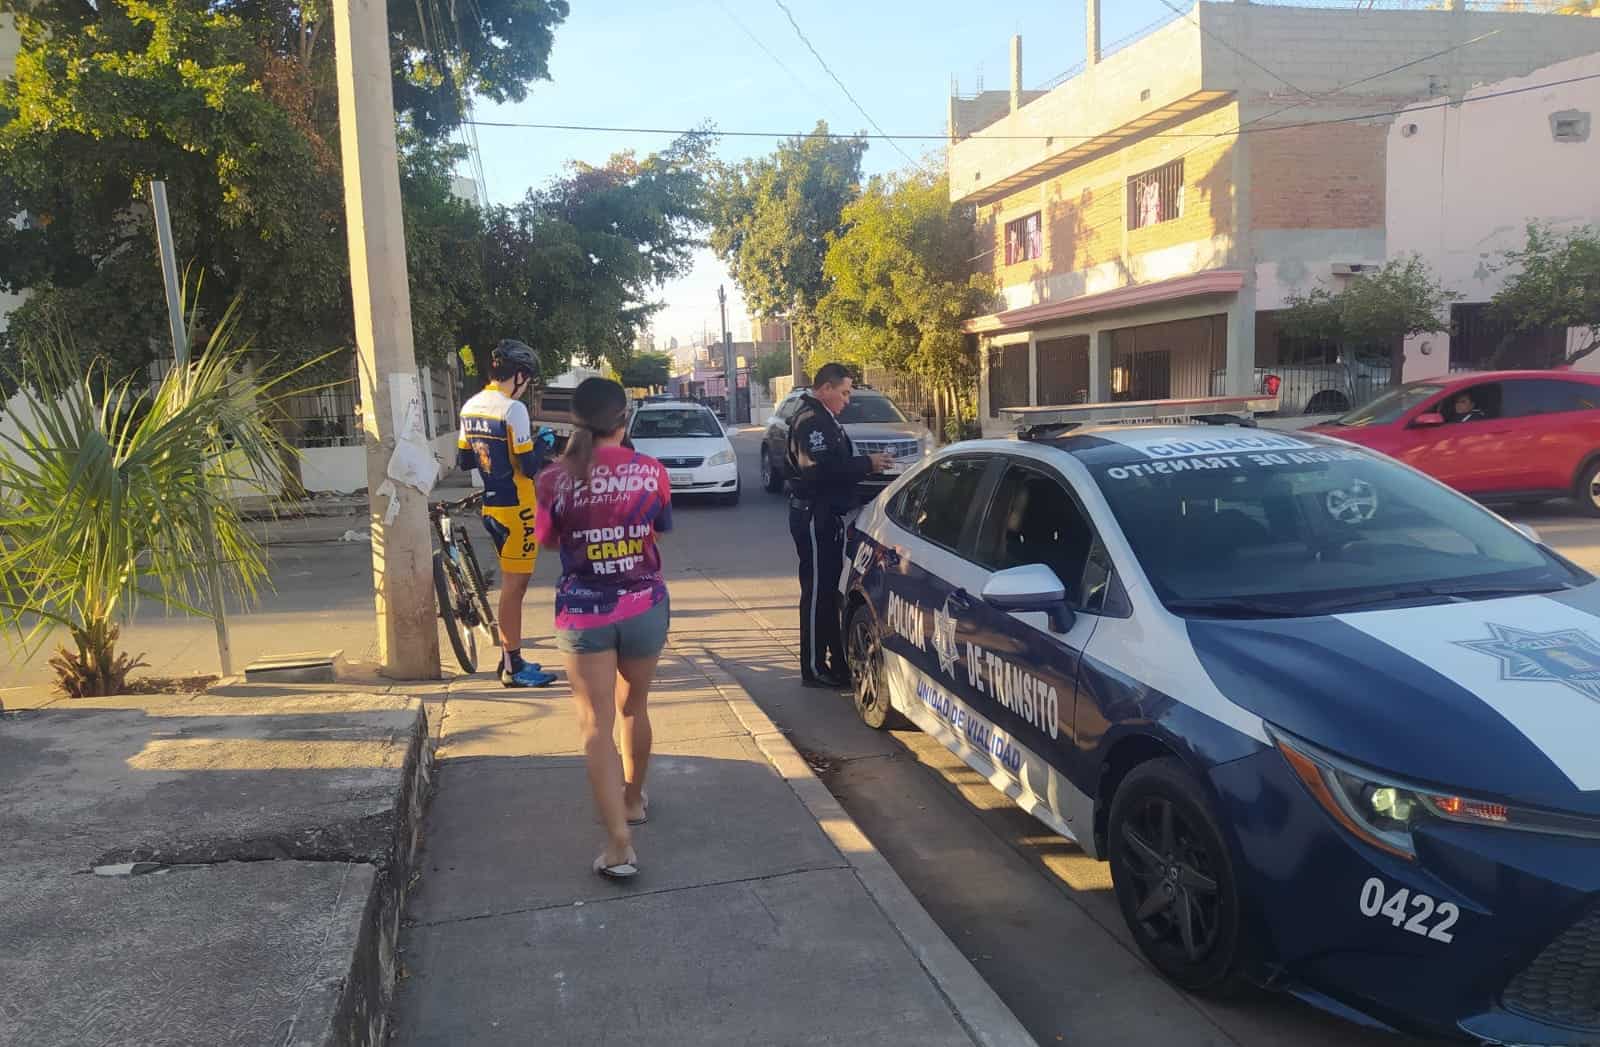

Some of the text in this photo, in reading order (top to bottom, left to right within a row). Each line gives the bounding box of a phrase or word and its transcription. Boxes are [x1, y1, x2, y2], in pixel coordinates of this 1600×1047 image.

[615, 463, 661, 477] GRAN
[519, 507, 535, 557] U.A.S.
[587, 539, 643, 560] GRAN
[628, 524, 651, 539] UN
[966, 639, 984, 692] DE
[985, 650, 1059, 741] TRANSITO
[917, 678, 1021, 772] UNIDAD DE VIALIDAD
[1359, 877, 1460, 944] 0422
